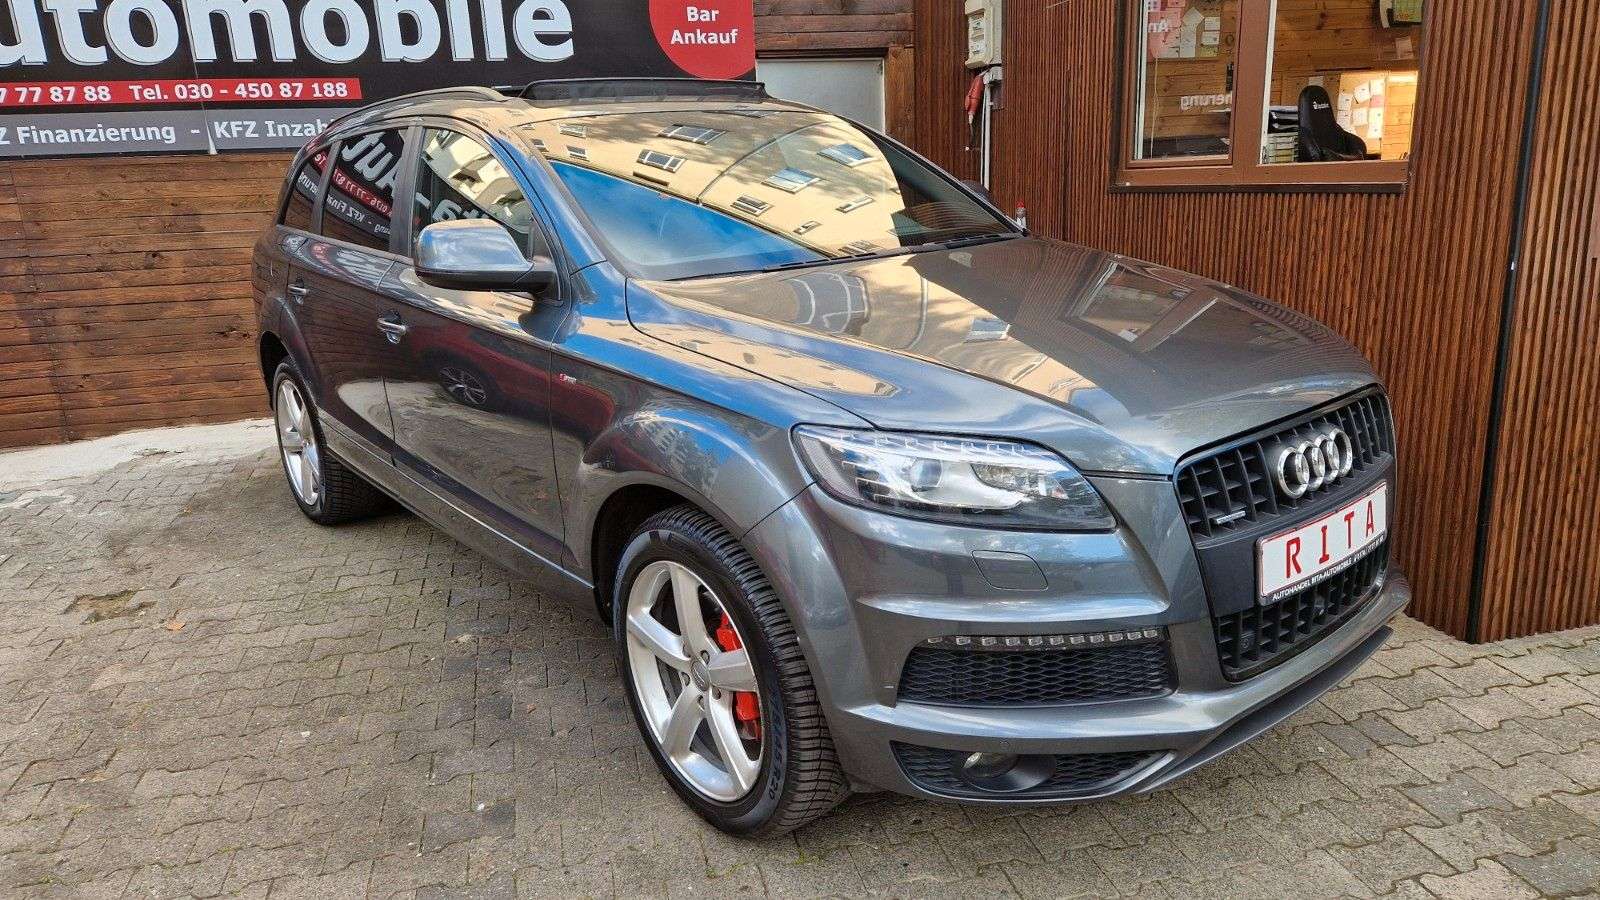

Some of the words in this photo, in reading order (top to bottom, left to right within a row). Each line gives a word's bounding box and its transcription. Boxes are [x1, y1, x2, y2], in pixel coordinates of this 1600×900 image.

[686, 7, 719, 22] Bar
[670, 30, 738, 45] Ankauf
[15, 86, 42, 103] 77
[50, 86, 75, 102] 87
[83, 85, 112, 102] 88
[129, 85, 168, 100] Tel.
[175, 83, 213, 99] 030
[235, 83, 273, 98] 450
[279, 83, 303, 98] 87
[312, 82, 348, 97] 188
[17, 124, 176, 144] Finanzierung
[214, 121, 259, 138] KFZ
[1286, 500, 1374, 578] RITA
